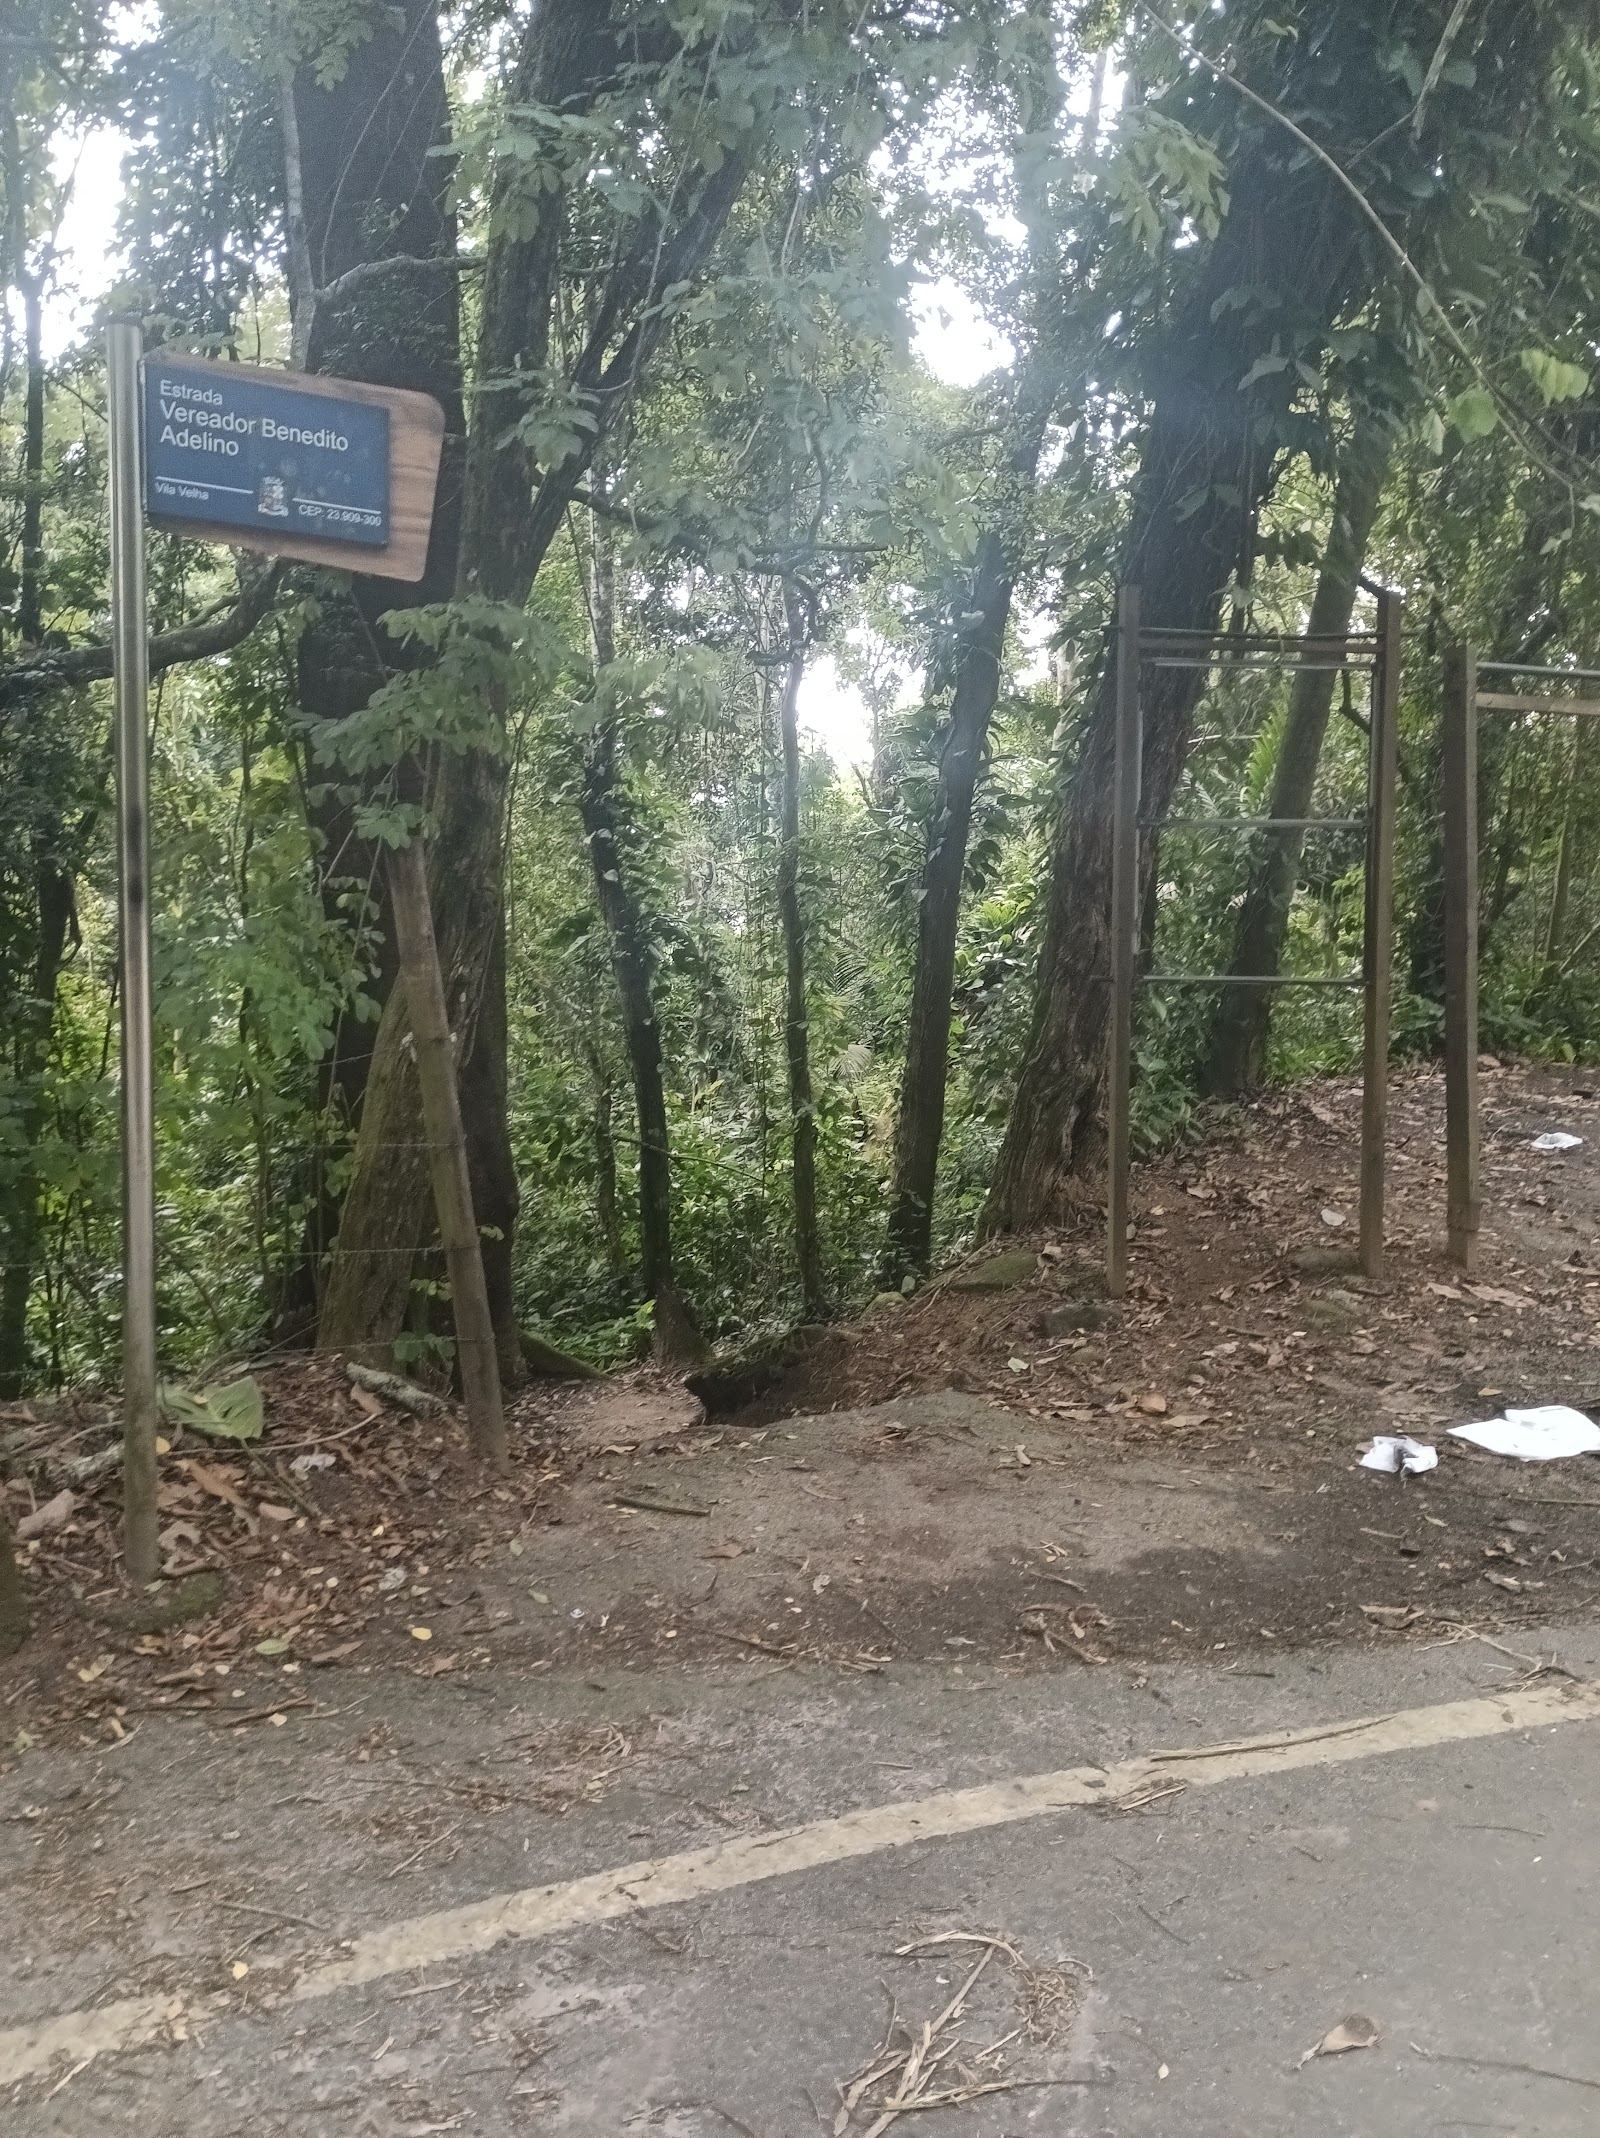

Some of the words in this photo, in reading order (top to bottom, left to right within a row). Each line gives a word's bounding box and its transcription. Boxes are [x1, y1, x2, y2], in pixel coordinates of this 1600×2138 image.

[160, 379, 223, 406] Estrada
[160, 398, 257, 434] Vereador
[261, 417, 349, 451] Benedito
[159, 424, 239, 456] Adelino
[155, 482, 176, 495] Vila
[178, 485, 209, 500] Velha
